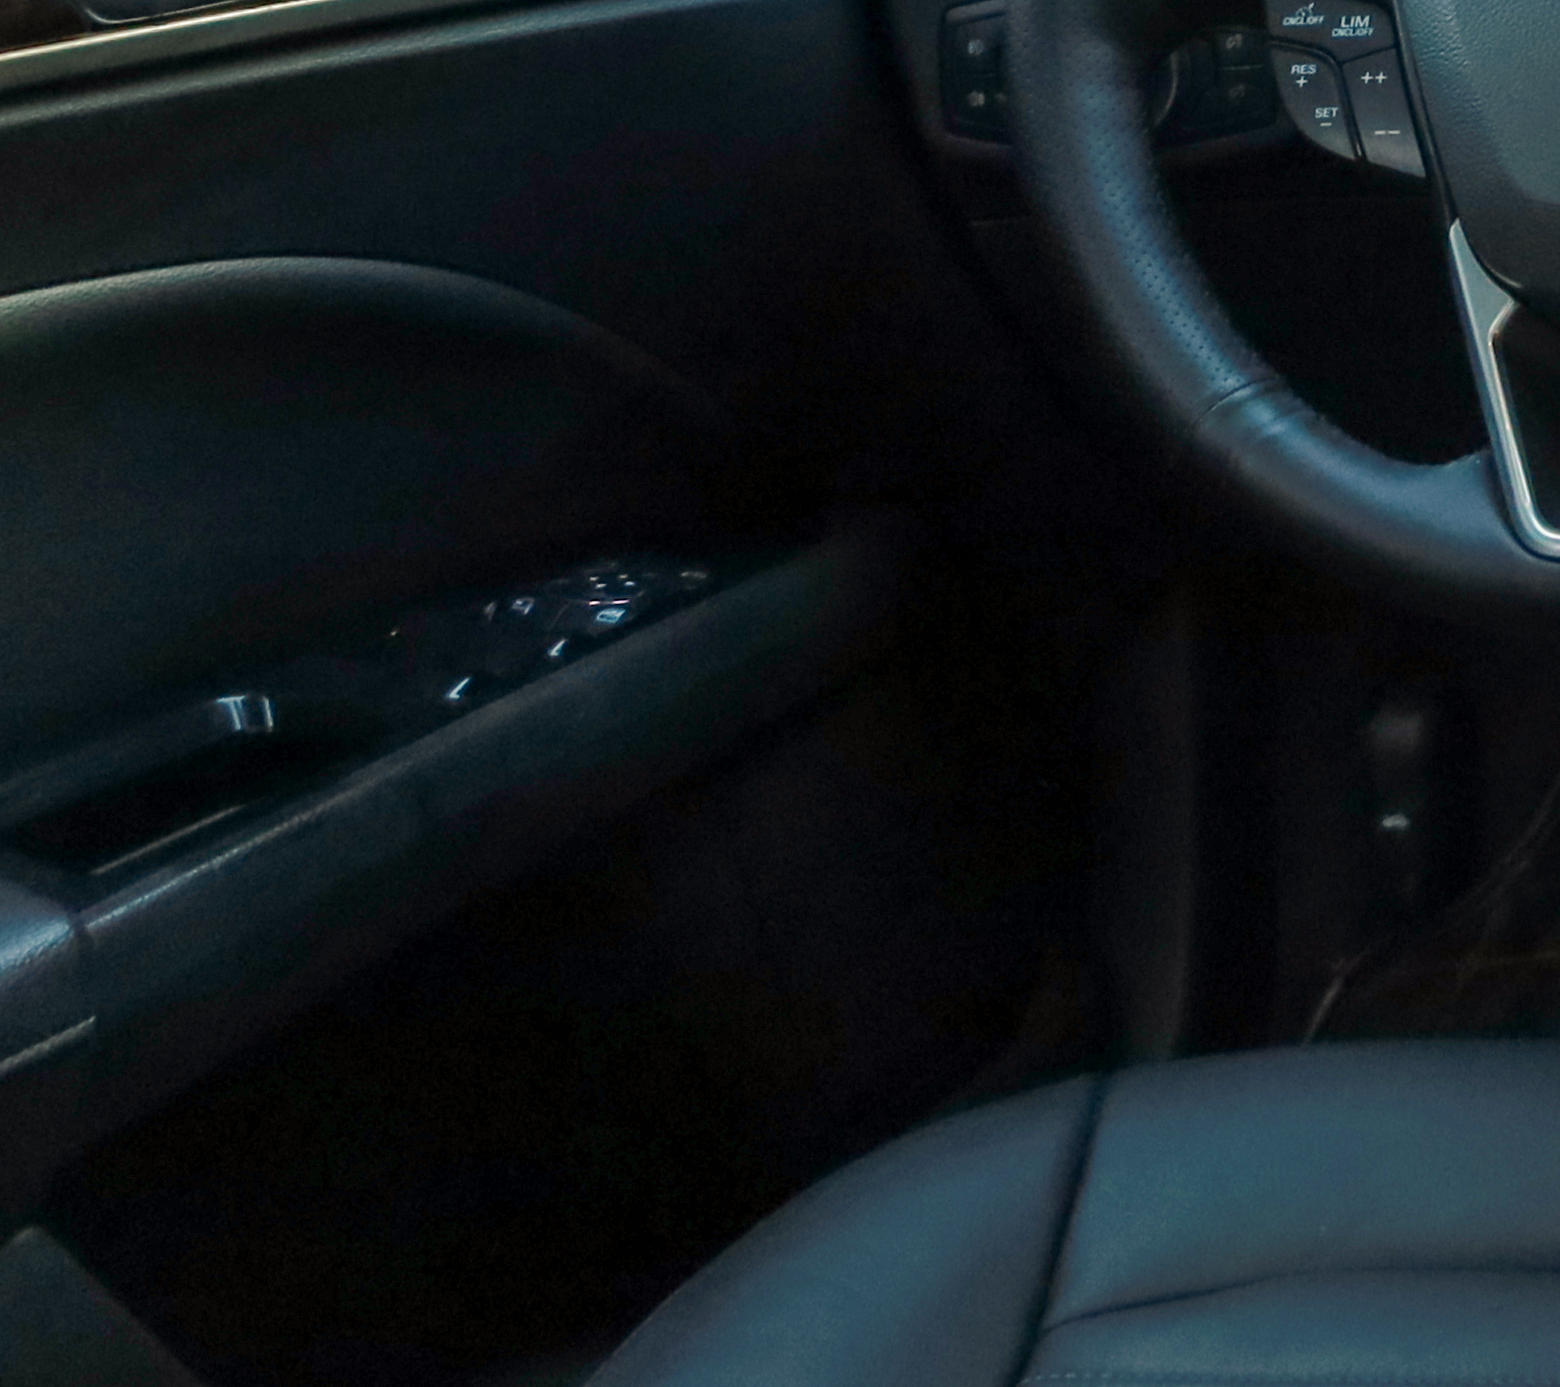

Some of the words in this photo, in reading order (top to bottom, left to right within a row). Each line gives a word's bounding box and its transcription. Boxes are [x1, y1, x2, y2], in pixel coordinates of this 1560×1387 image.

[1340, 15, 1370, 28] LIM
[1290, 64, 1317, 75] RES
[1314, 107, 1339, 119] SET
